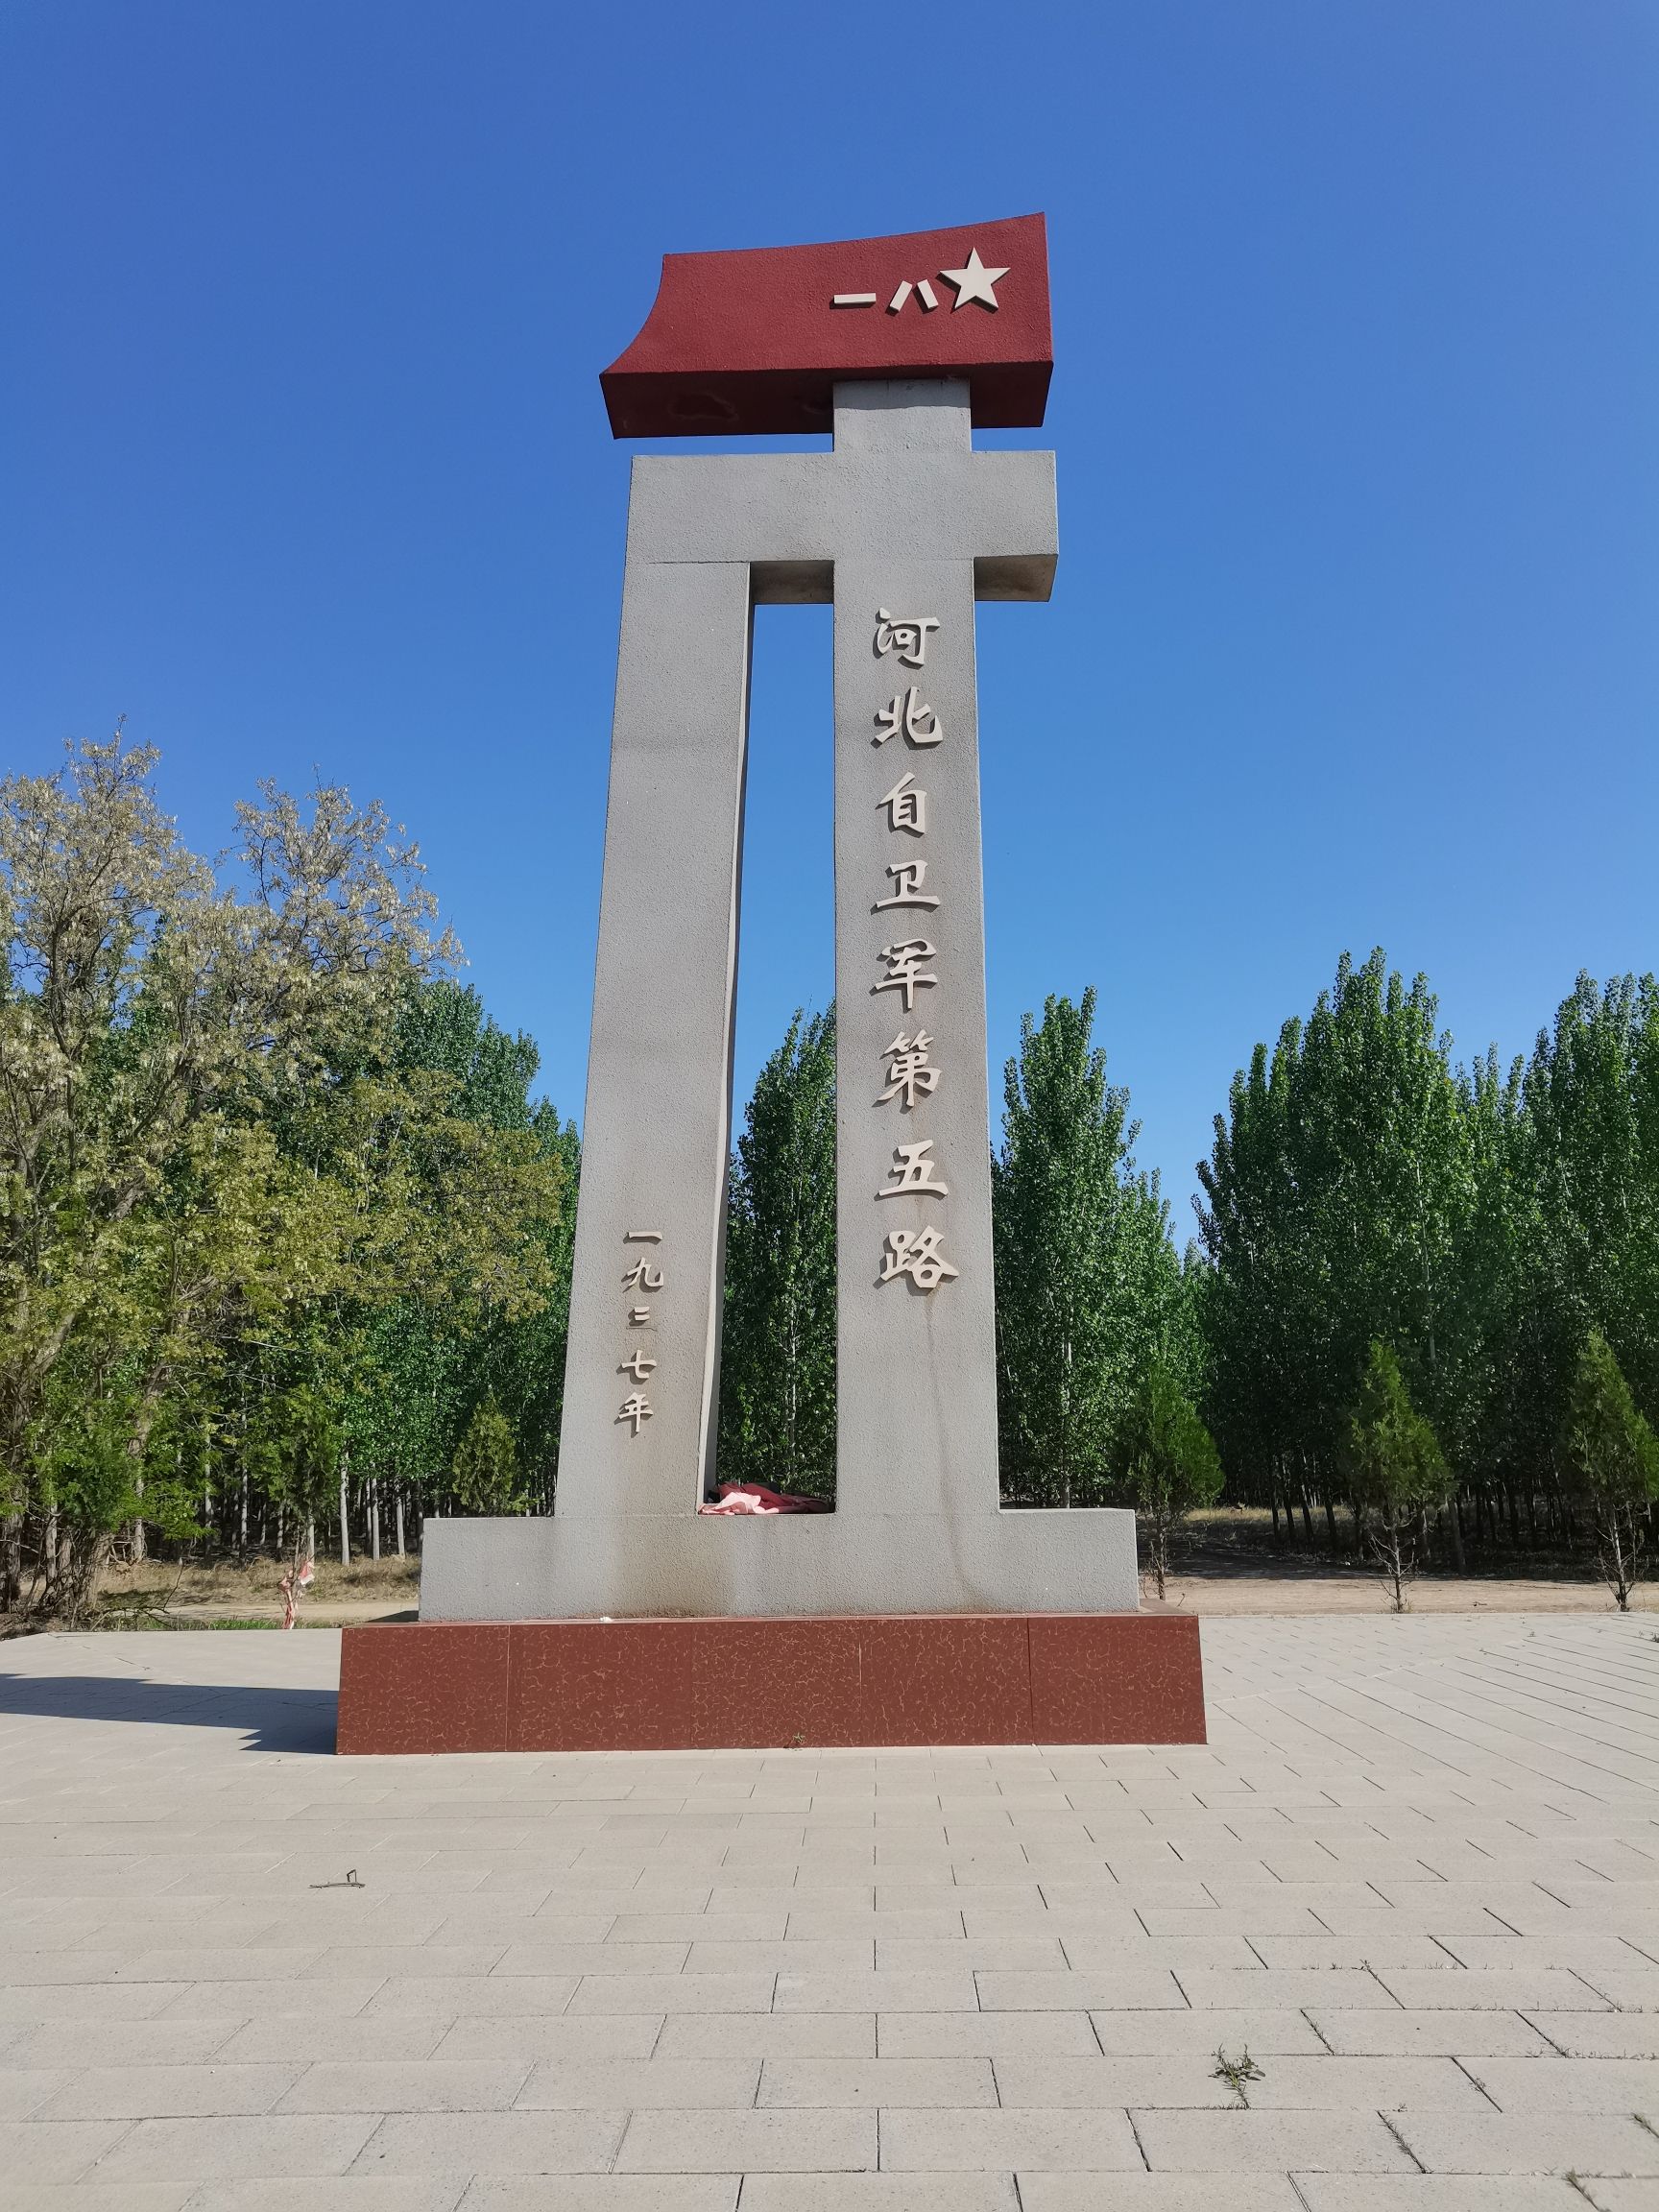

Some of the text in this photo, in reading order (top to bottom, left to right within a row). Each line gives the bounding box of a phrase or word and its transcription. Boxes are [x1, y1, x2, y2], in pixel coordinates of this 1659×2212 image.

[872, 607, 959, 1289] 河北自卫军第五路
